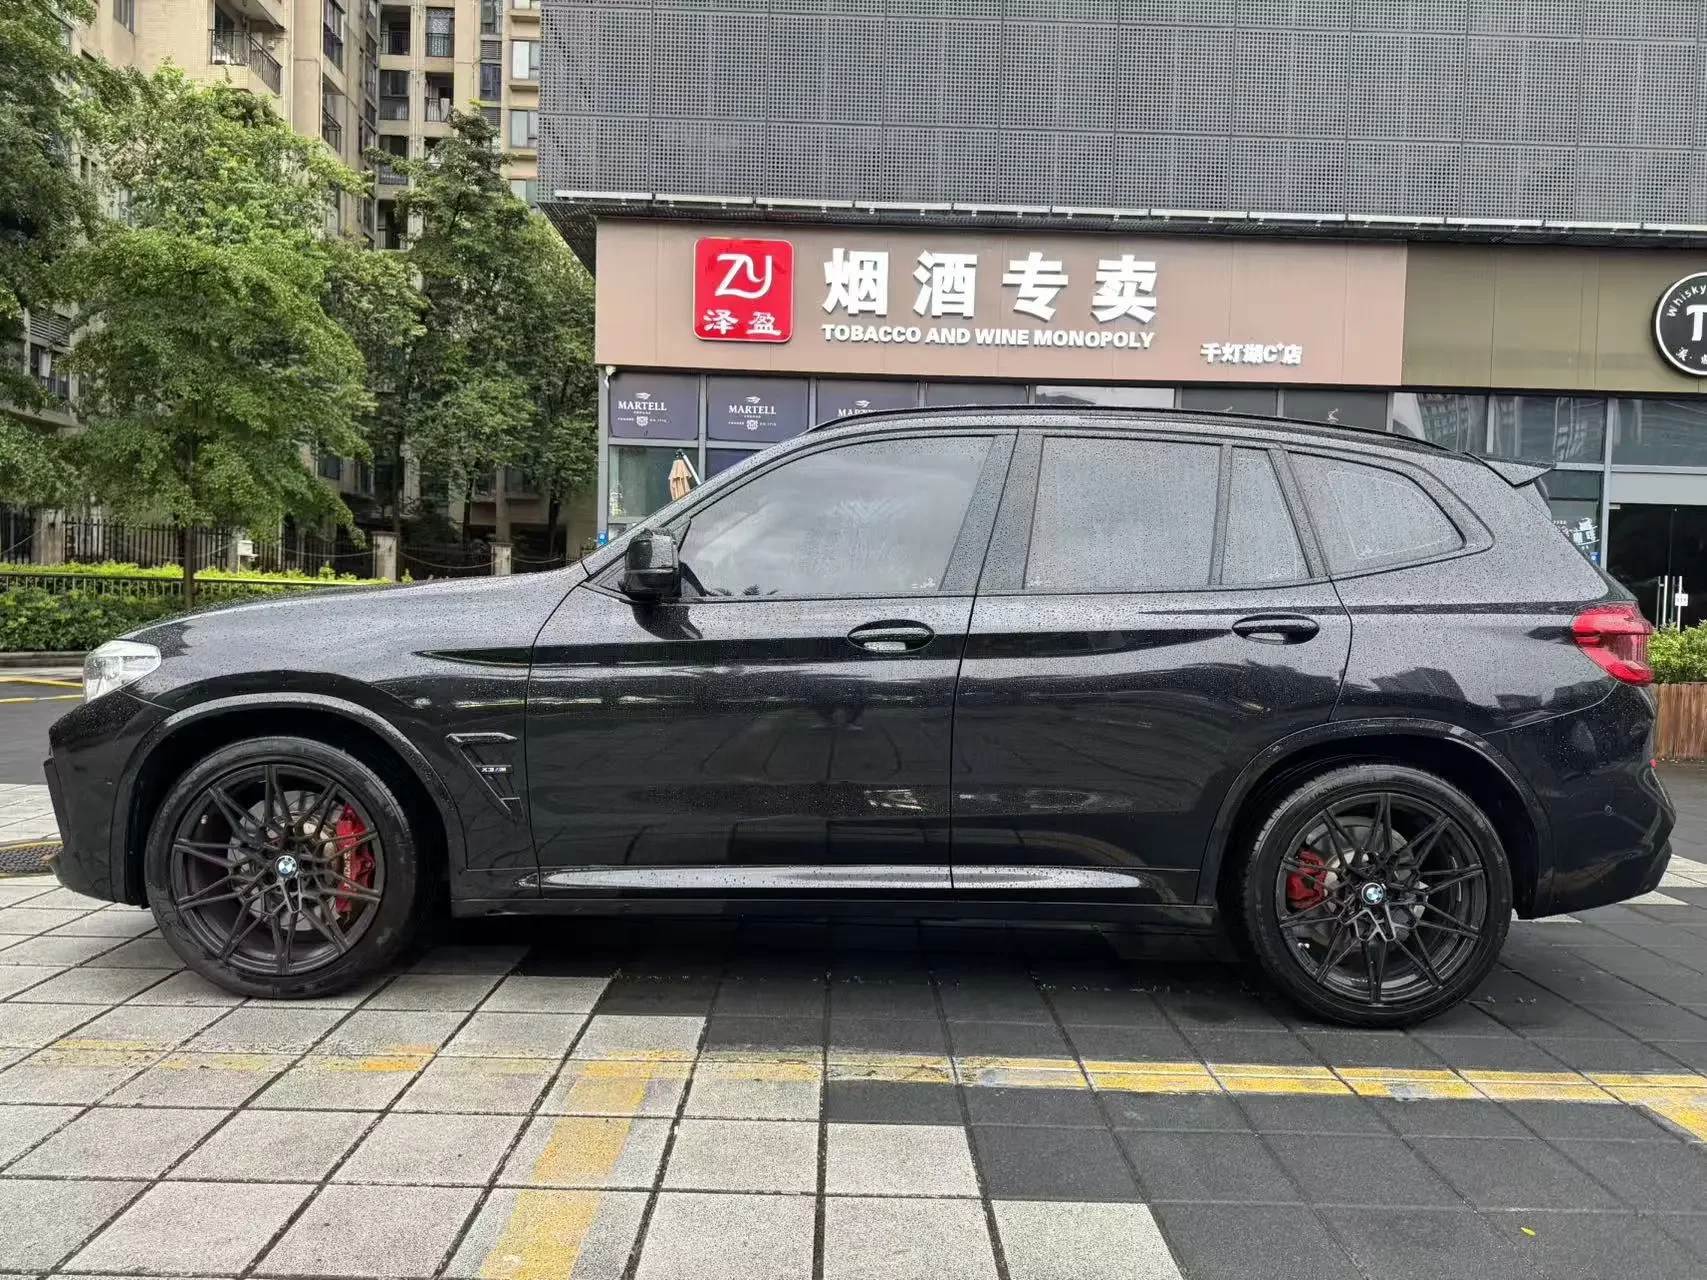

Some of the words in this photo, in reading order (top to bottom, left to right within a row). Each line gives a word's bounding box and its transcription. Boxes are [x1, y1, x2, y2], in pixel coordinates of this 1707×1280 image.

[822, 248, 1157, 323] 烟酒专卖
[1667, 284, 1706, 317] Whisky
[703, 309, 782, 336] 泽盈
[822, 324, 922, 343] TOBACCO
[925, 327, 971, 345] AND
[975, 328, 1030, 345] WINE
[1033, 329, 1156, 349] MONOPOLY
[617, 400, 667, 411] MARTELL
[728, 405, 776, 415] MARTELL
